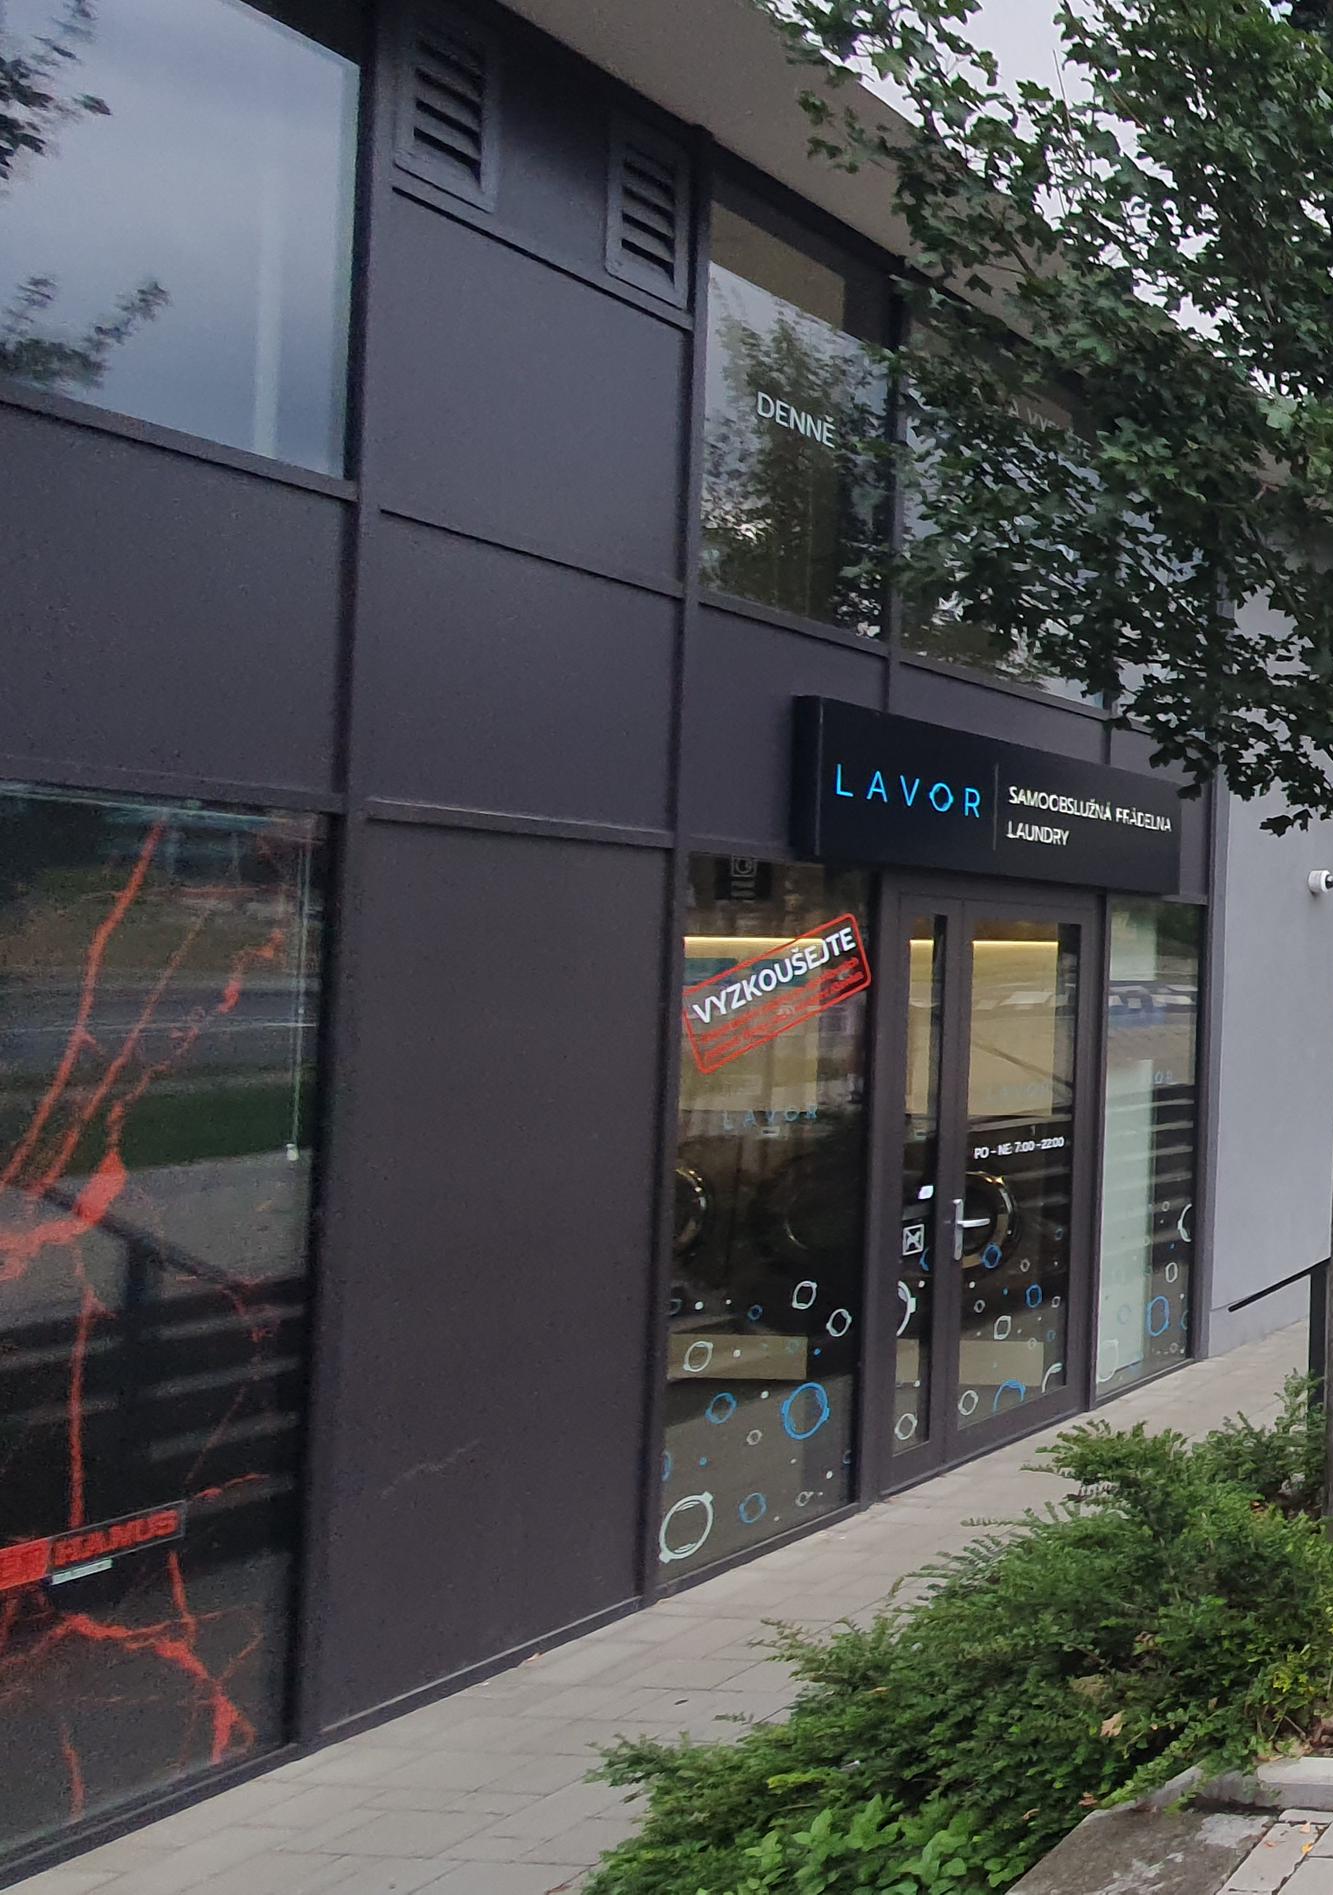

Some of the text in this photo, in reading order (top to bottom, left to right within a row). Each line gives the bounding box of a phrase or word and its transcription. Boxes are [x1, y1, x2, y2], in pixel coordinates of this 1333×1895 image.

[757, 391, 836, 449] DENNĚ
[836, 763, 980, 818] LAVOR
[1006, 820, 1070, 846] LAUNDRY
[692, 927, 857, 1024] VYZKOUŠEJTE
